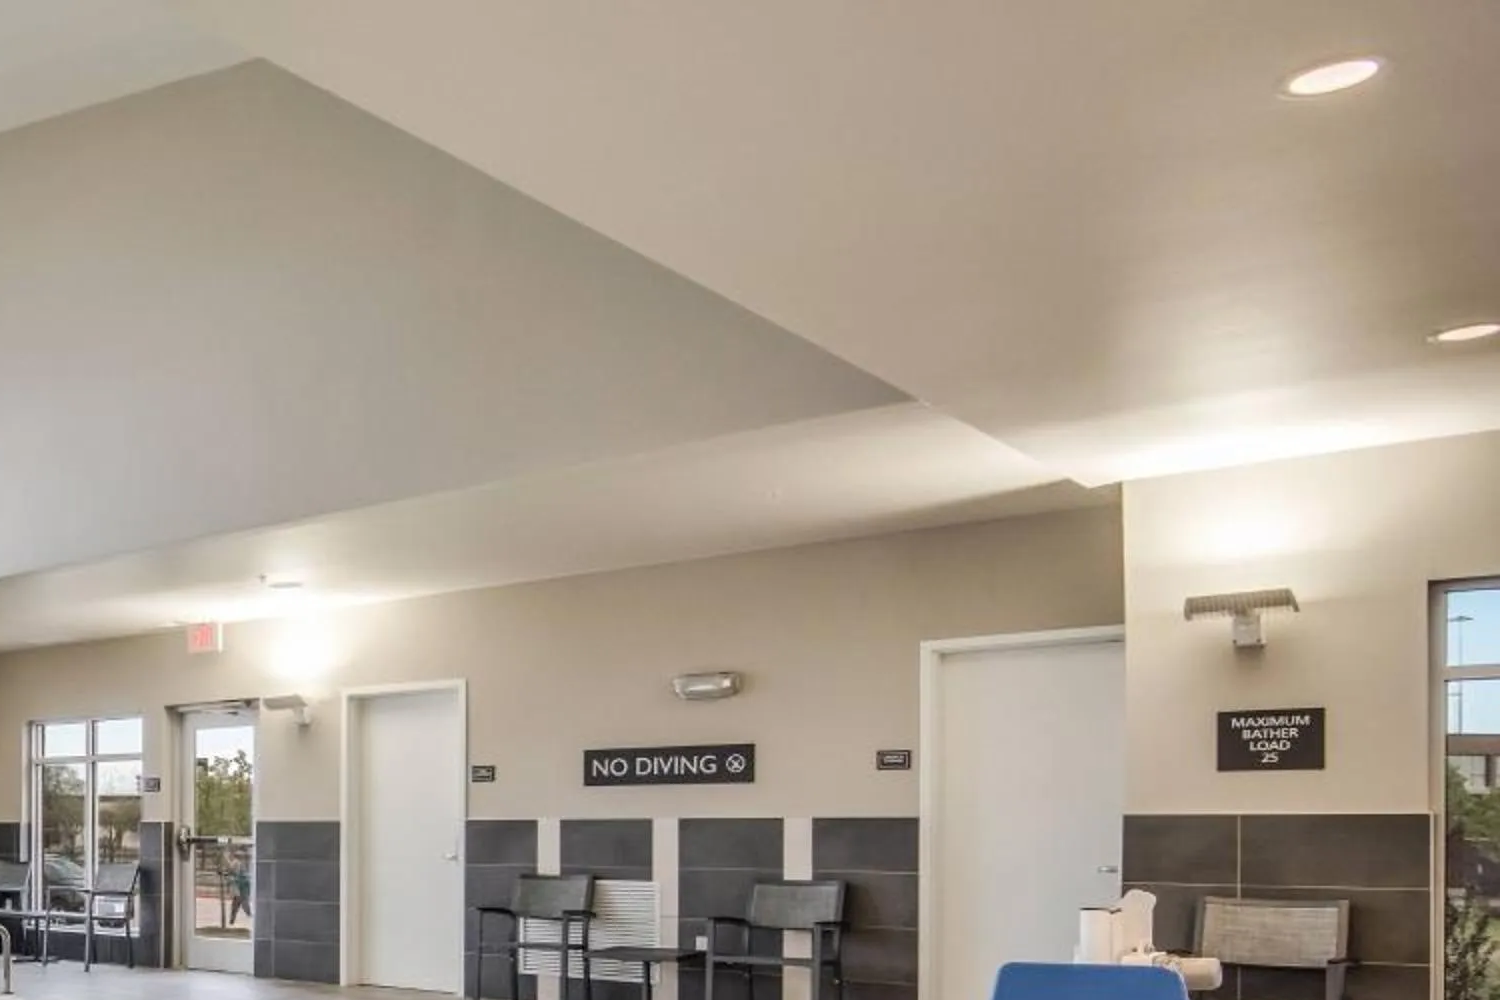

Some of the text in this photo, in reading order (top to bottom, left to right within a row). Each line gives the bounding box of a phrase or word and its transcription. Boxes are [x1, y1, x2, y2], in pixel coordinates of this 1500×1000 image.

[1231, 715, 1311, 729] MAXIMUM
[1241, 727, 1299, 740] BATHER
[1249, 740, 1291, 751] LOAD
[1261, 752, 1279, 763] 25
[591, 754, 717, 777] NO DIVING
